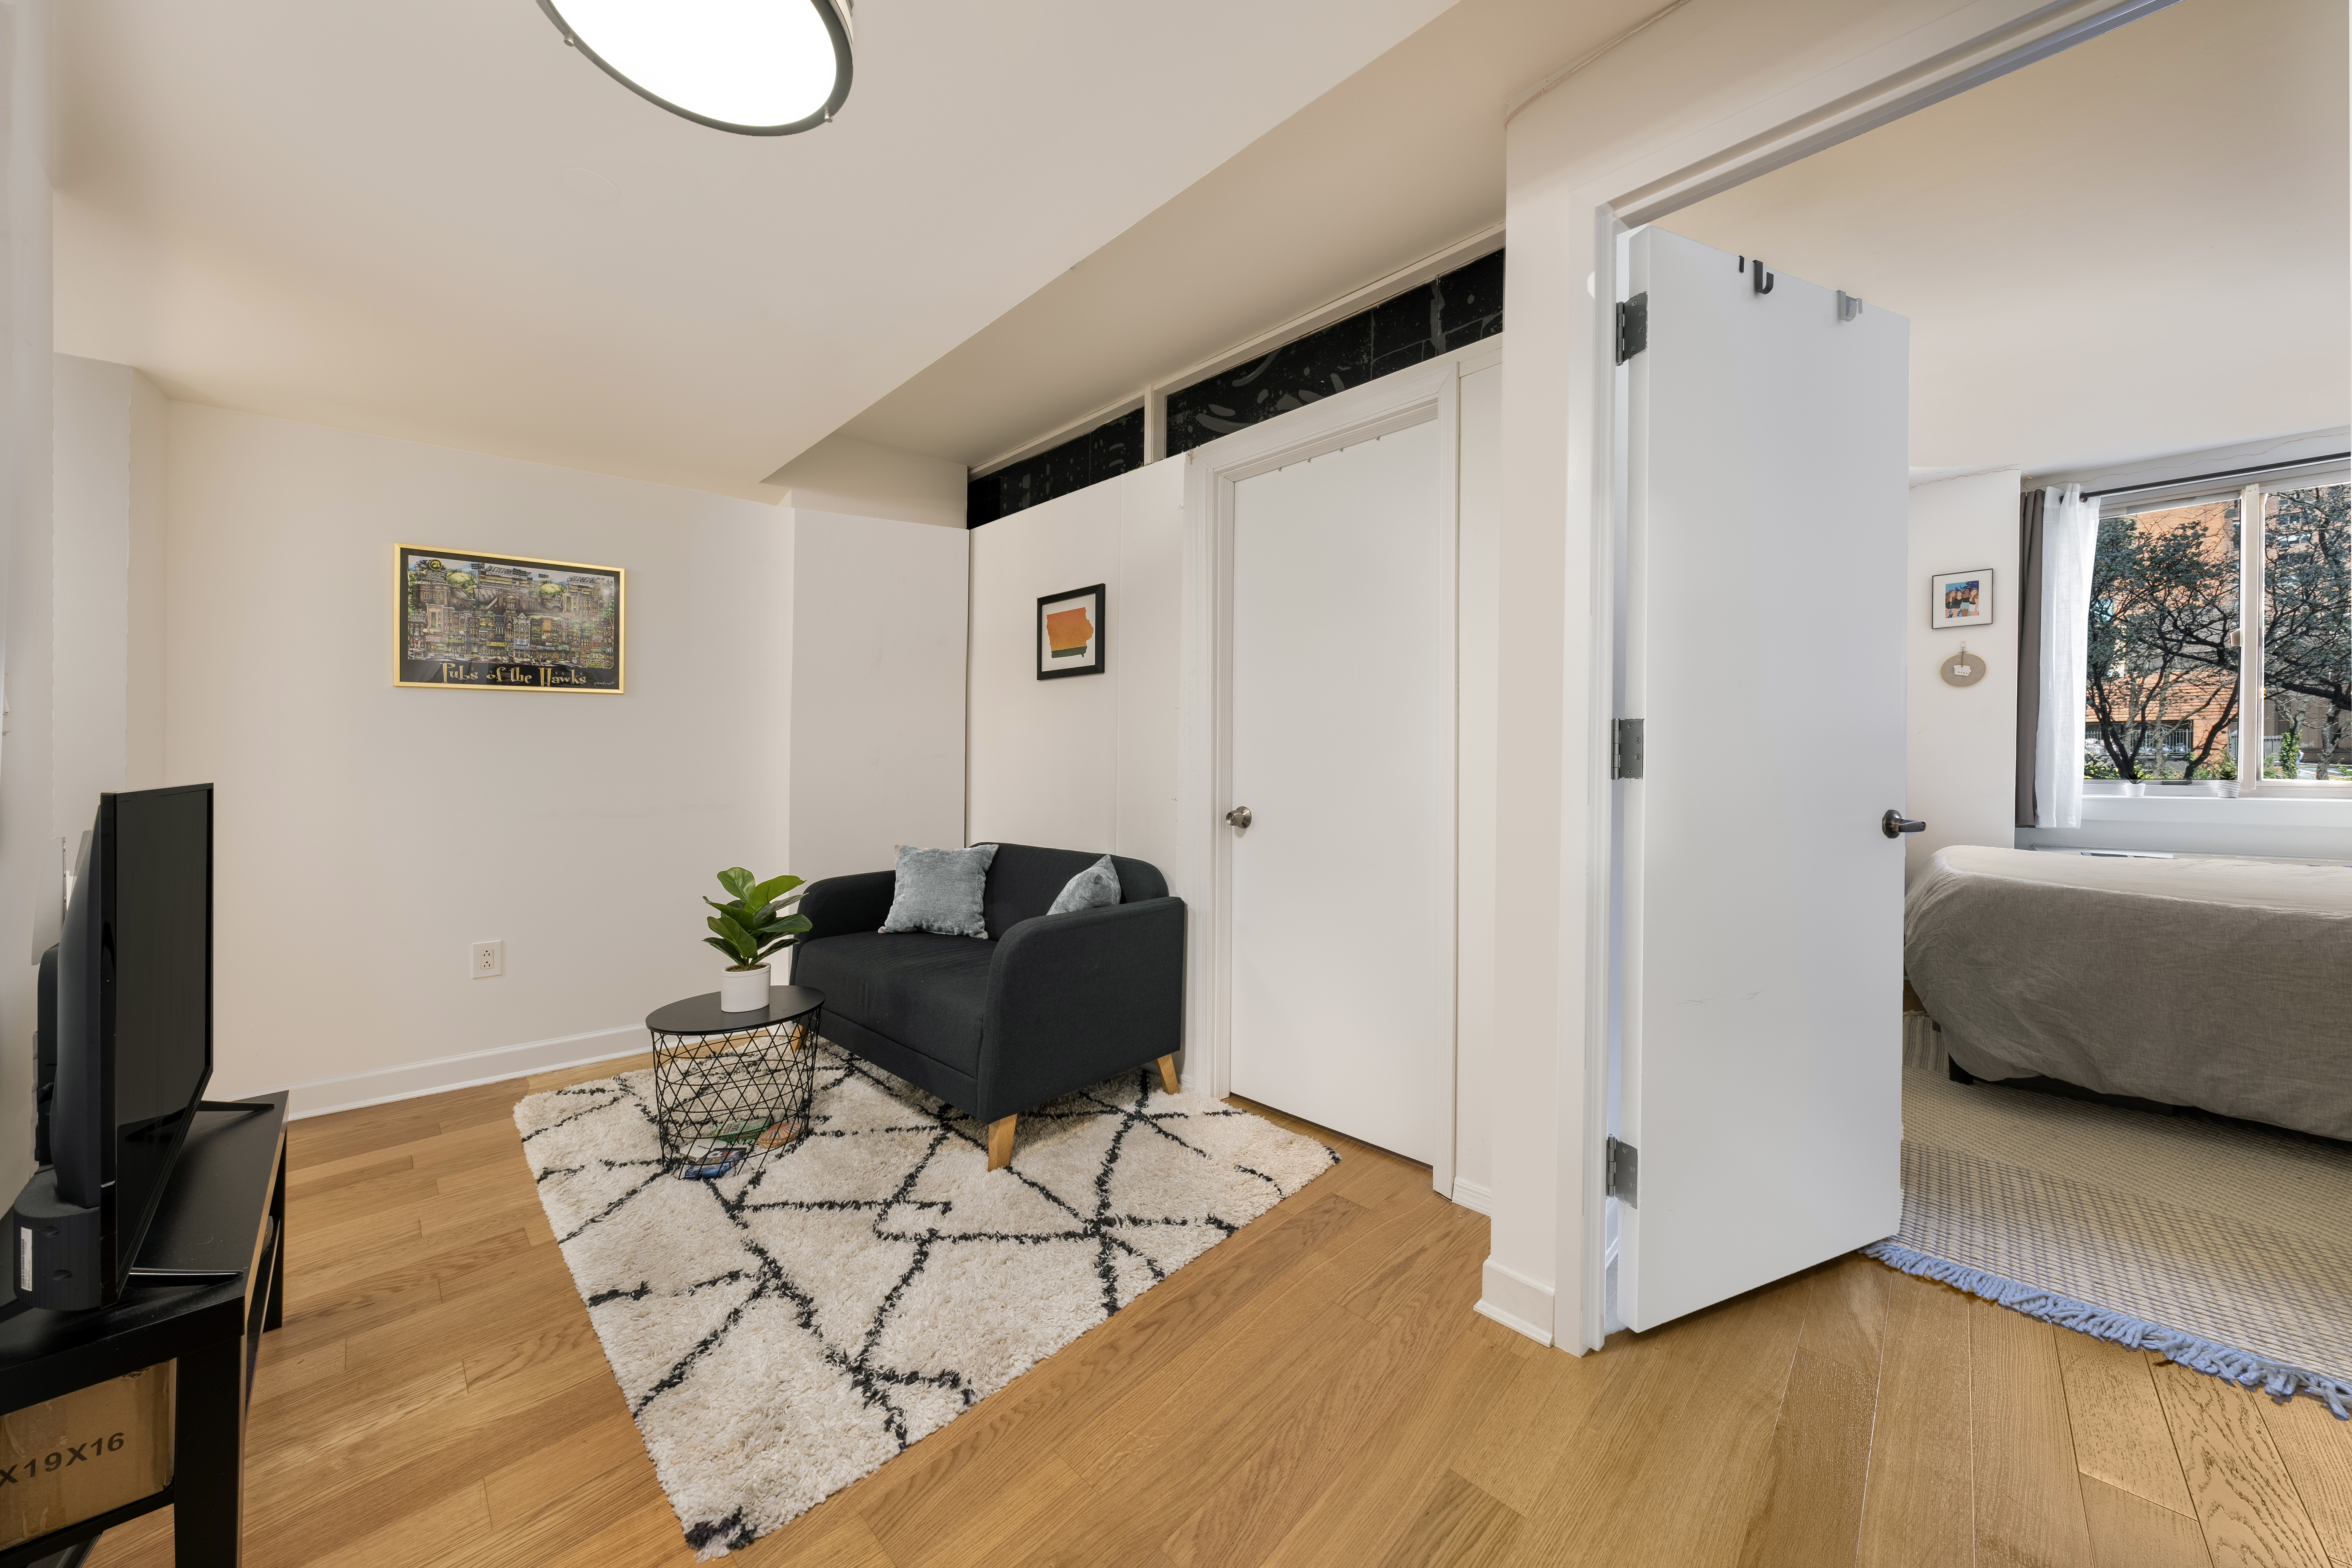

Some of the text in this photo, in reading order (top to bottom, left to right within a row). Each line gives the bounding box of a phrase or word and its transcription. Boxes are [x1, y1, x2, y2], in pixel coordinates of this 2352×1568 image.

[439, 663, 586, 687] Pubs of the Hawks
[0, 1432, 124, 1488] X19X16
